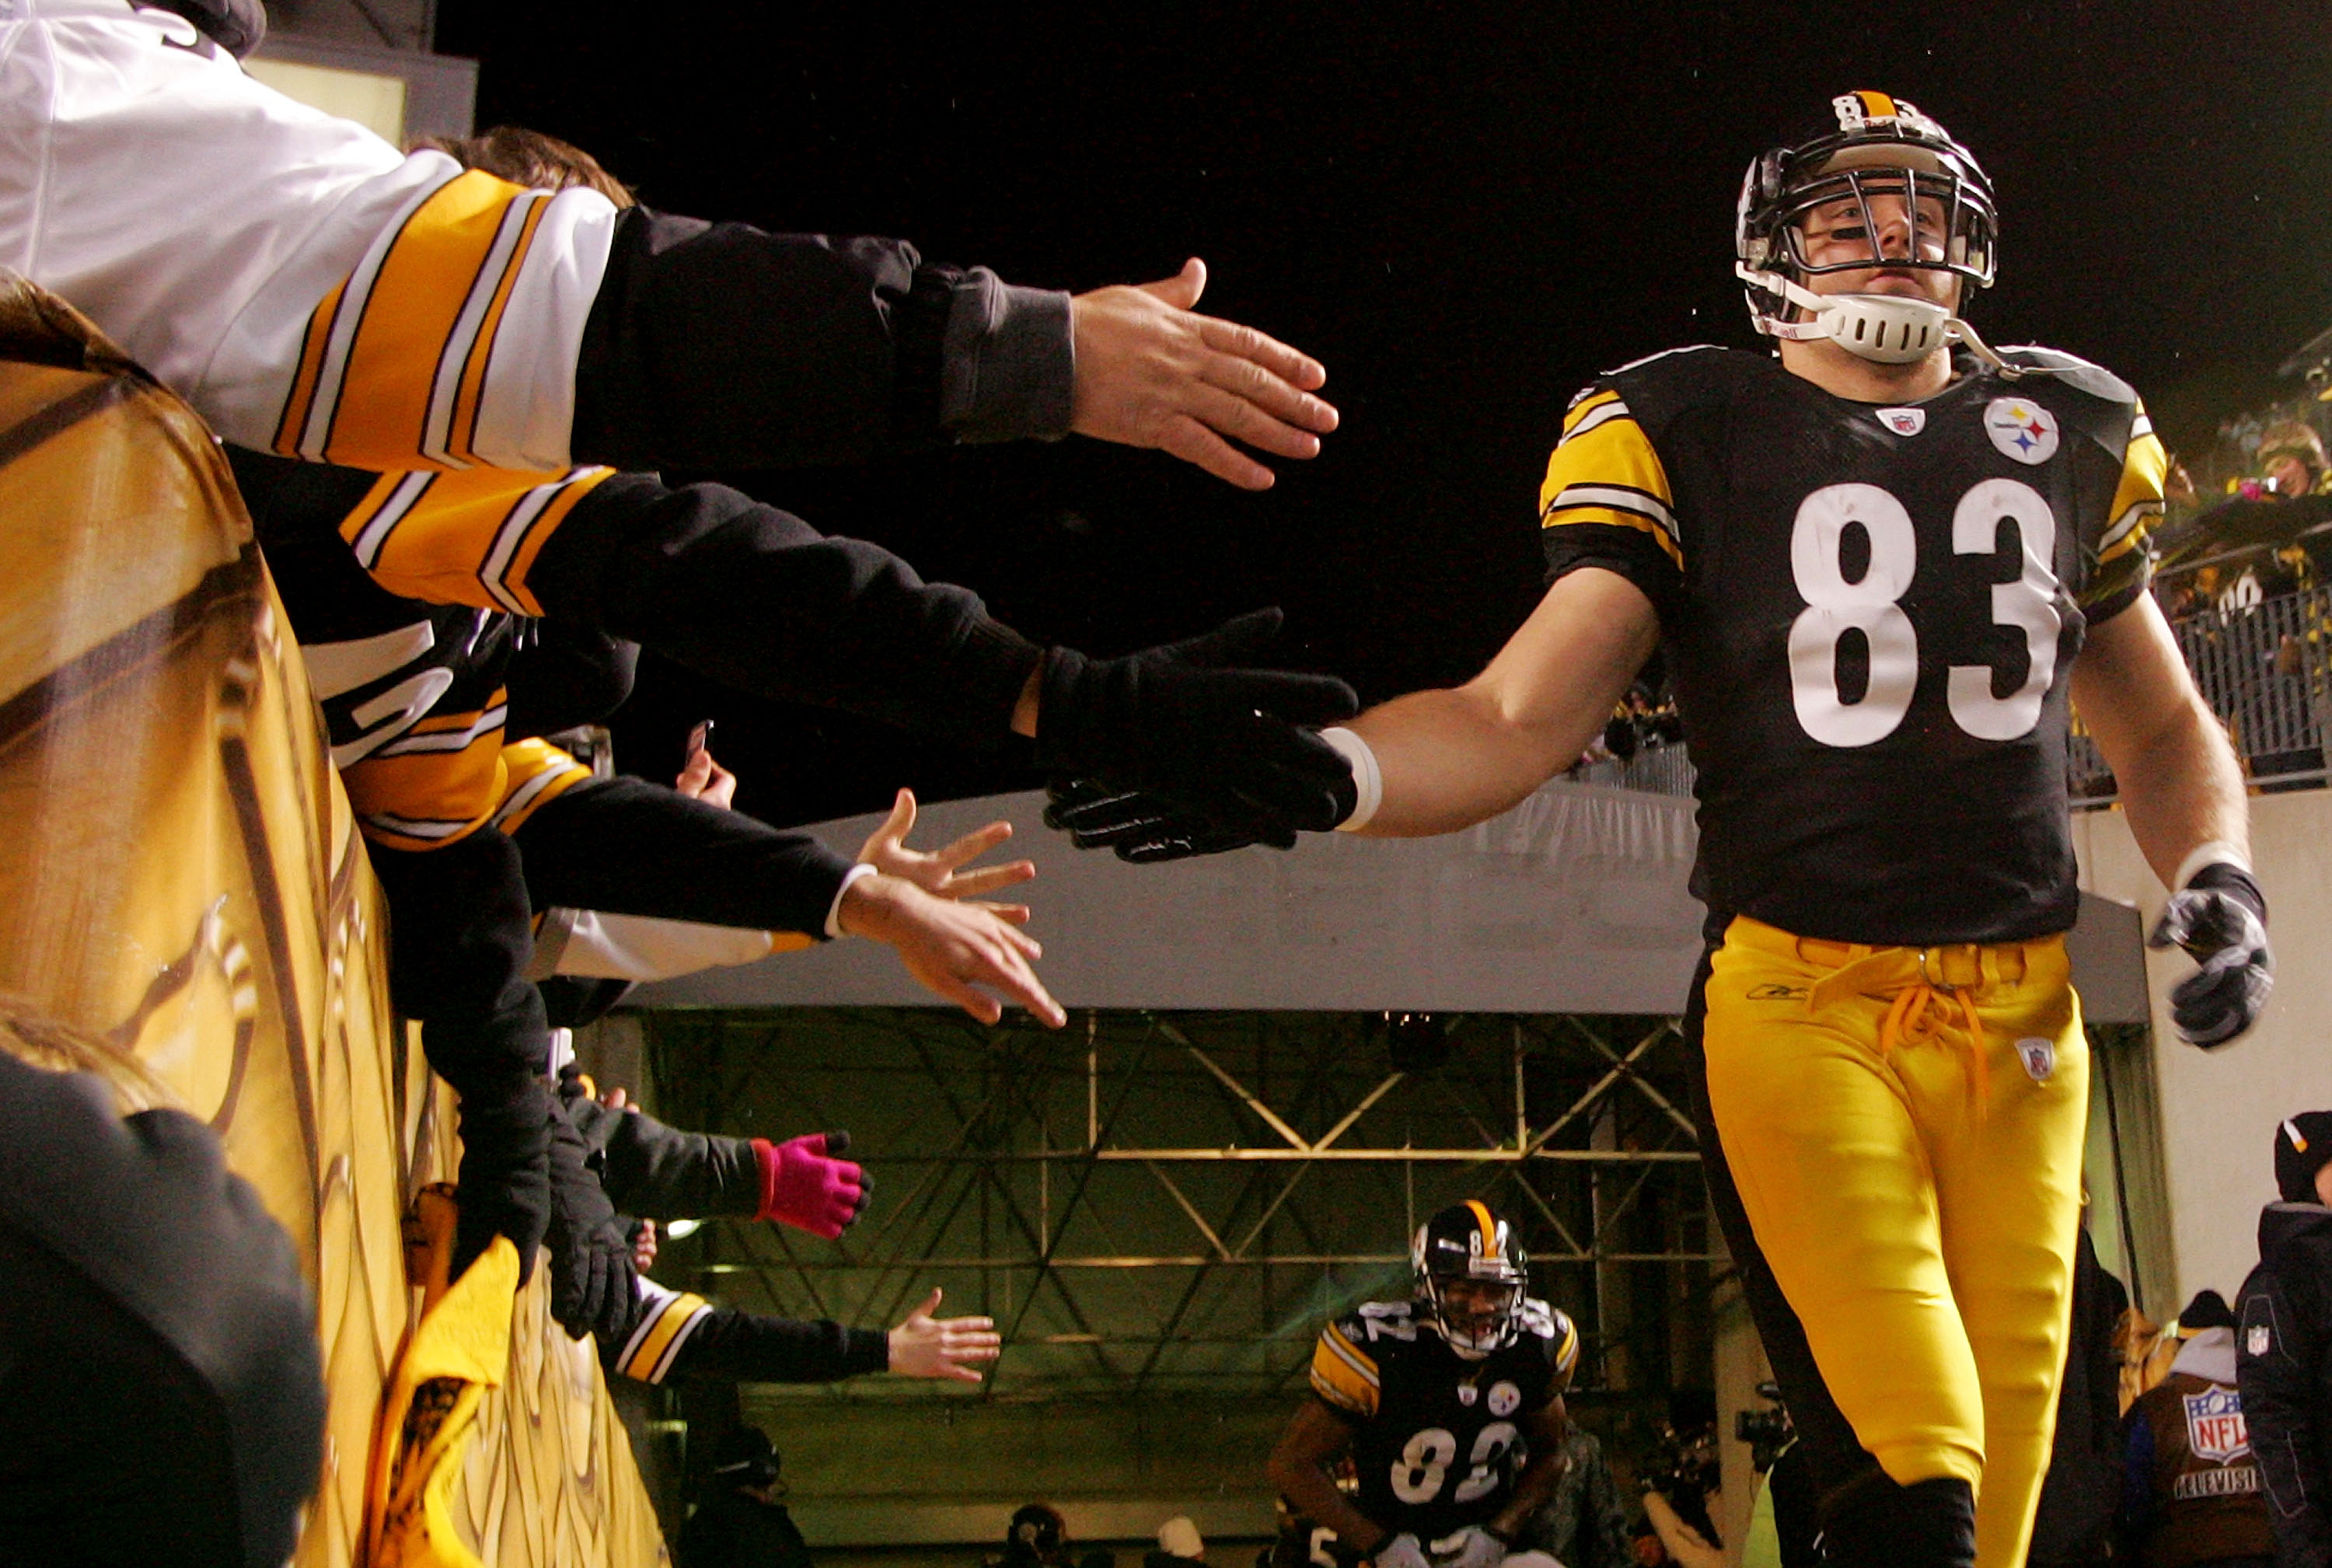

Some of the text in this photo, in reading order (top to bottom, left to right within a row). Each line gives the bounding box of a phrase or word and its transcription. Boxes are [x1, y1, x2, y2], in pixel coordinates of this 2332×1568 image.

[1788, 478, 2062, 747] 83
[1391, 1421, 1518, 1504] 82
[2196, 1416, 2249, 1451] NFL
